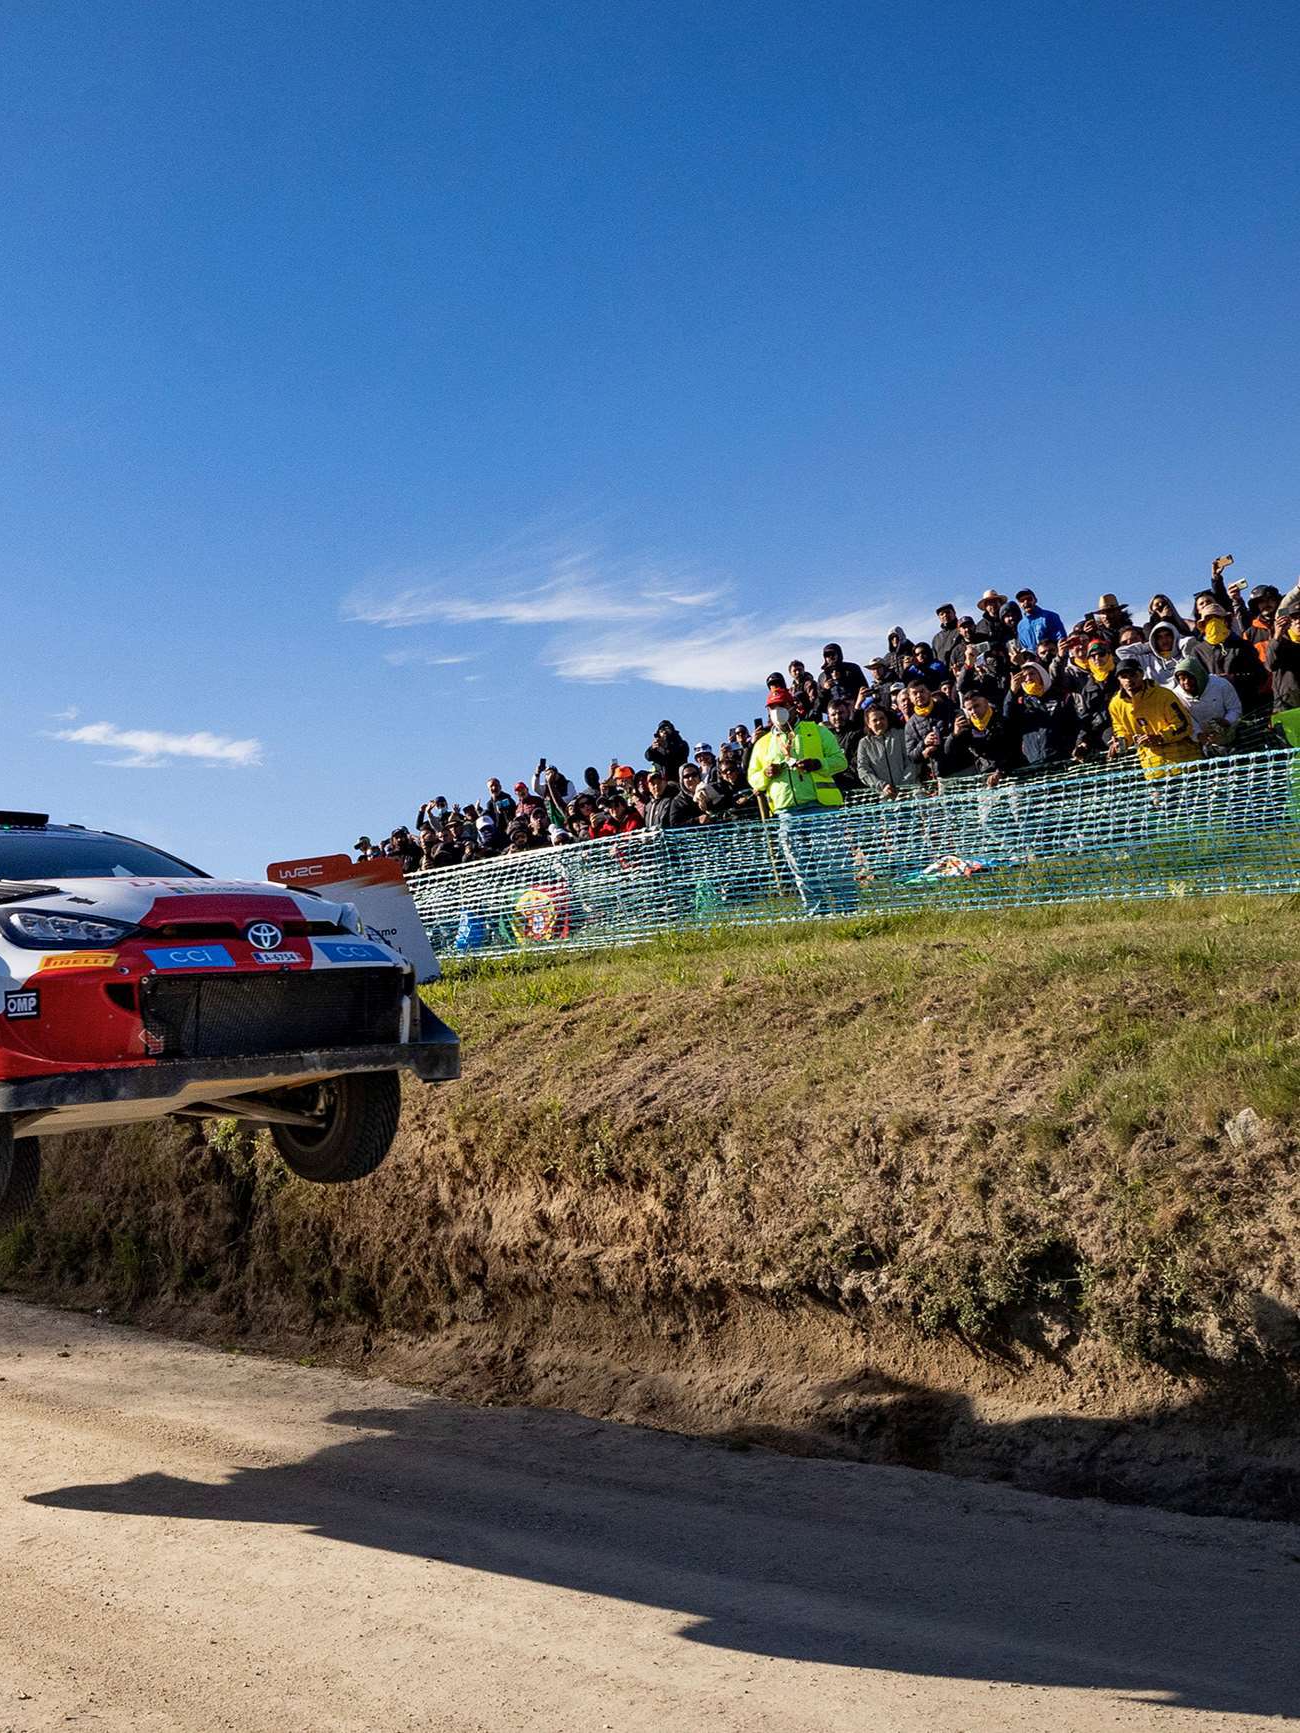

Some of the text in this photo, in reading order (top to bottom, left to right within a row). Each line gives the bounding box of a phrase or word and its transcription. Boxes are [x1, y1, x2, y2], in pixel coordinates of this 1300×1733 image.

[279, 864, 324, 880] WRC
[44, 955, 111, 967] PIRELLI
[6, 996, 37, 1013] OMP
